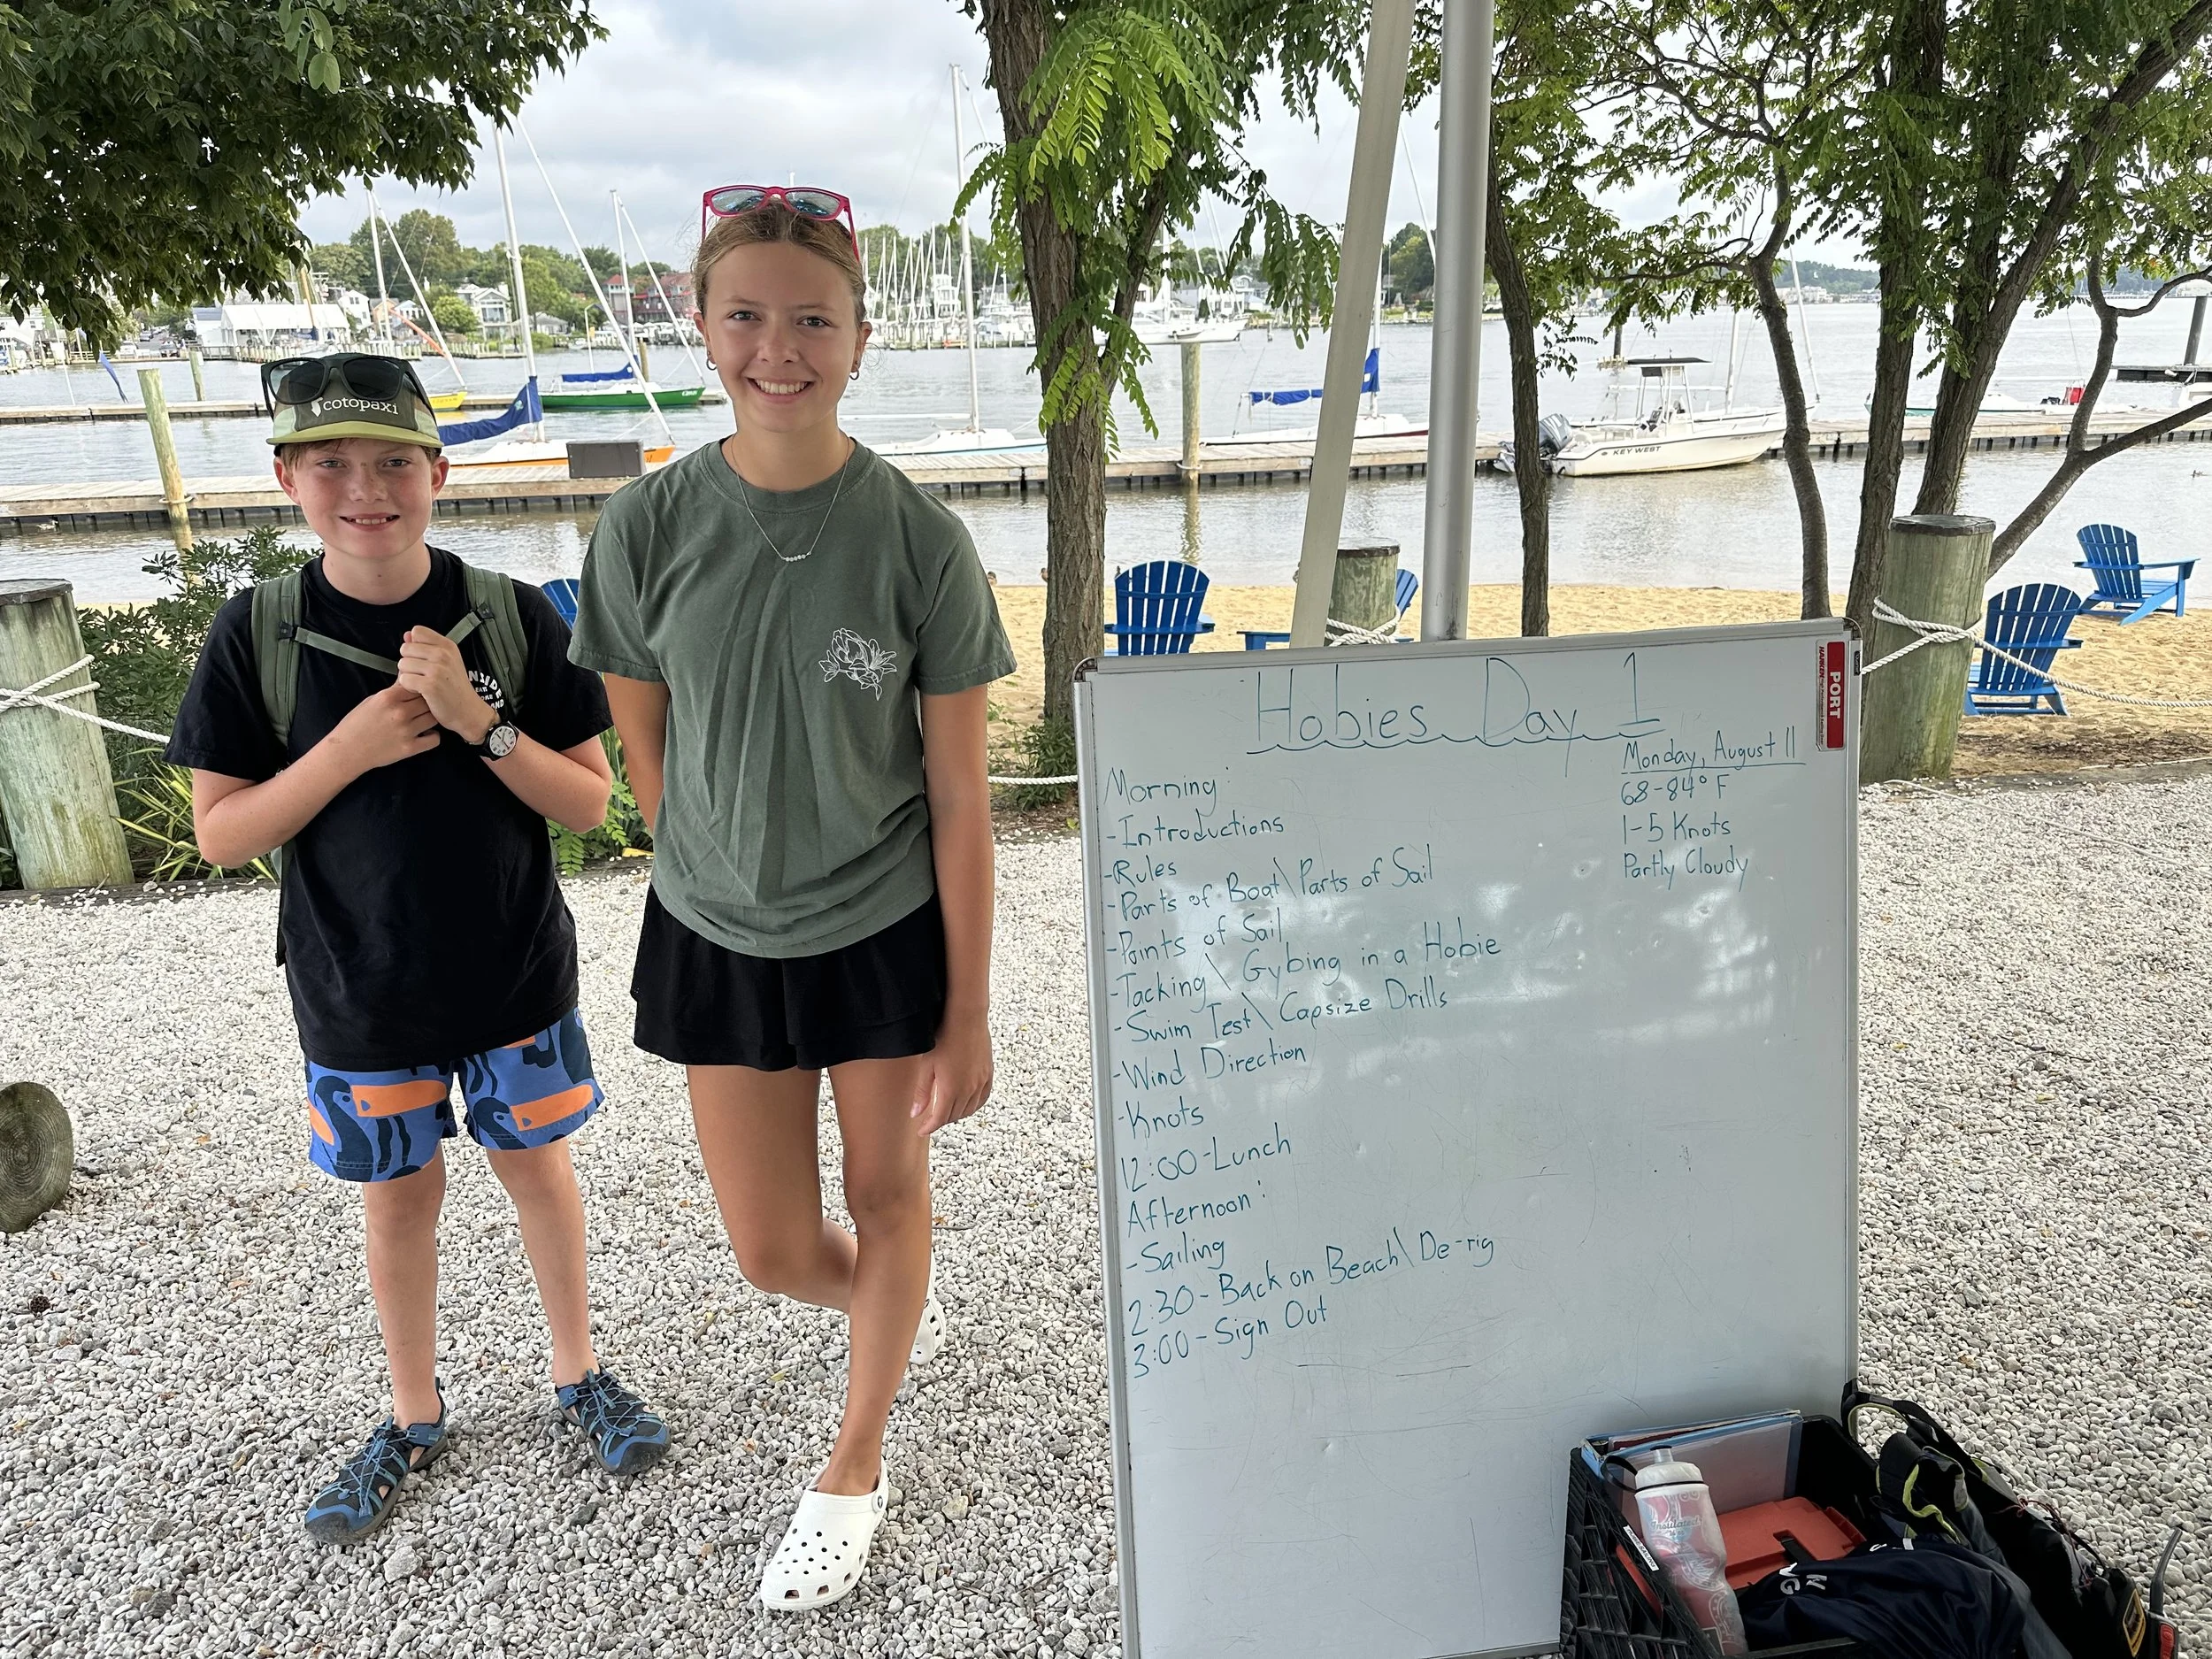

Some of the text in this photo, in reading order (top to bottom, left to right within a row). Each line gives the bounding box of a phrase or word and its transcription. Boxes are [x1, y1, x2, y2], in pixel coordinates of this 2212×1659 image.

[323, 397, 398, 415] cotopaxi
[1257, 652, 1661, 778] Hobies Day 1
[1830, 672, 1841, 718] PORT
[1623, 738, 1706, 774] Monday,
[1714, 730, 1776, 771] August
[1623, 811, 1732, 845] 1-5 Knots
[1188, 884, 1213, 908] of
[1361, 856, 1384, 887] of
[1391, 843, 1433, 887] Sail
[1624, 845, 1749, 892] Partly Cloudy
[1203, 914, 1226, 947] of
[1241, 907, 1282, 942] Sail
[1361, 947, 1379, 966] in
[1394, 949, 1408, 966] a
[1422, 917, 1502, 962] Hobie
[1385, 974, 1448, 1010] Drills
[1201, 1038, 1306, 1079] Direction
[1290, 1268, 1314, 1287] on
[1285, 1294, 1327, 1328] Out
